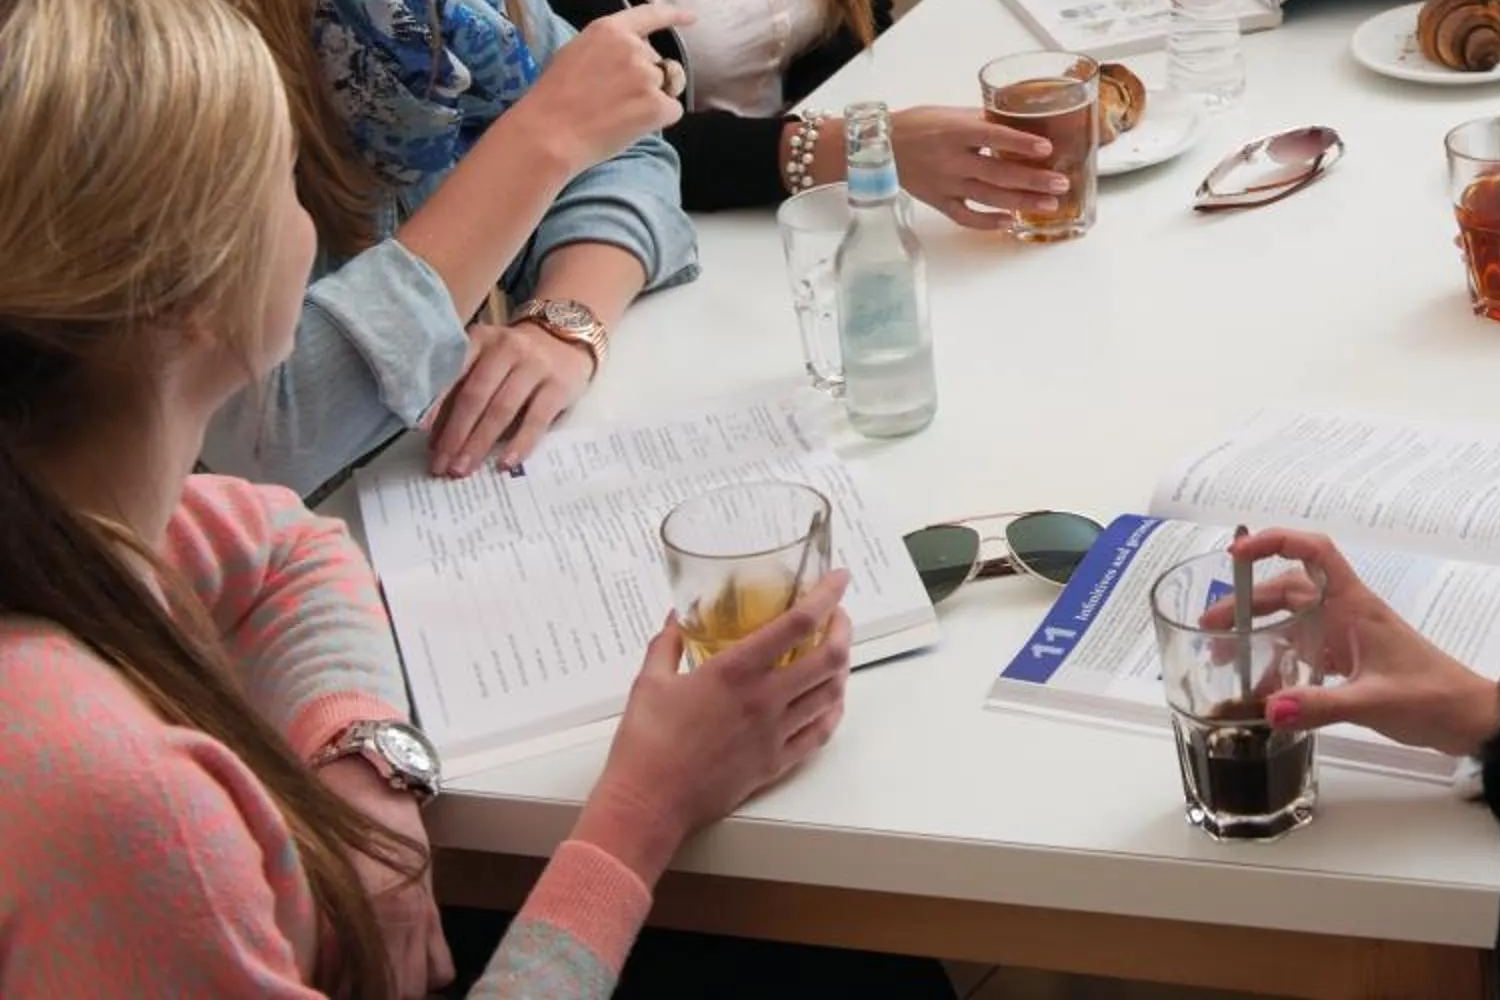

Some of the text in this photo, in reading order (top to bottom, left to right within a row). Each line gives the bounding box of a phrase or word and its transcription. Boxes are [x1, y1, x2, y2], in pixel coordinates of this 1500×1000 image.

[1031, 626, 1077, 659] 11
[1074, 568, 1117, 622] Infinitives
[1112, 547, 1131, 571] and
